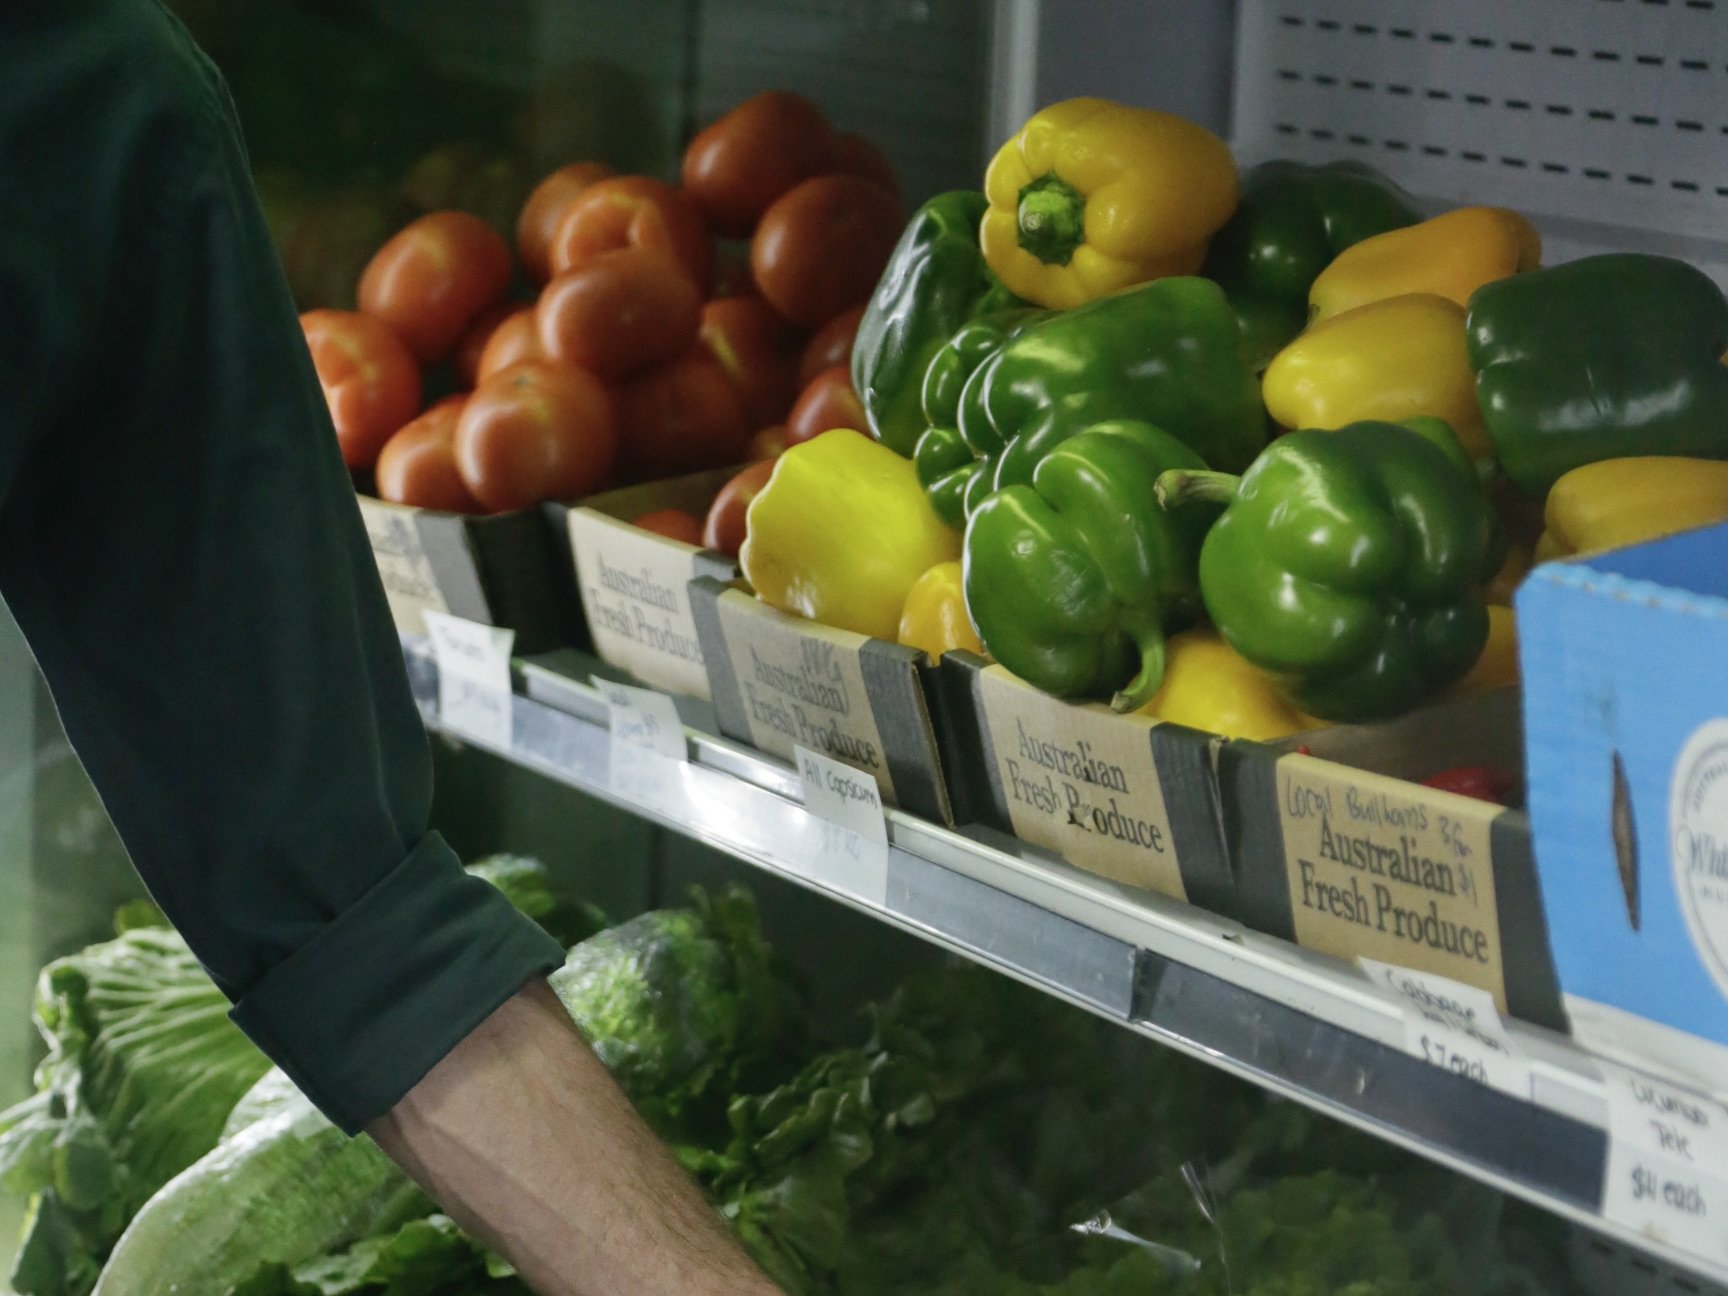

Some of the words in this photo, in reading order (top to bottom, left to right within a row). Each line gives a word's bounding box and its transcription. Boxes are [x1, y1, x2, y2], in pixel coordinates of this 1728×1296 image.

[589, 588, 632, 639] Fresh
[597, 552, 679, 614] Australian
[748, 643, 846, 715] Australian
[744, 681, 797, 738] Fresh
[791, 703, 880, 769] Produce
[1017, 718, 1129, 794] Australian
[1005, 757, 1062, 814] Fresh
[1062, 781, 1164, 853] Poduce
[1319, 812, 1457, 896] Australian
[1298, 859, 1371, 926] Fresh
[1373, 883, 1489, 964] Produce
